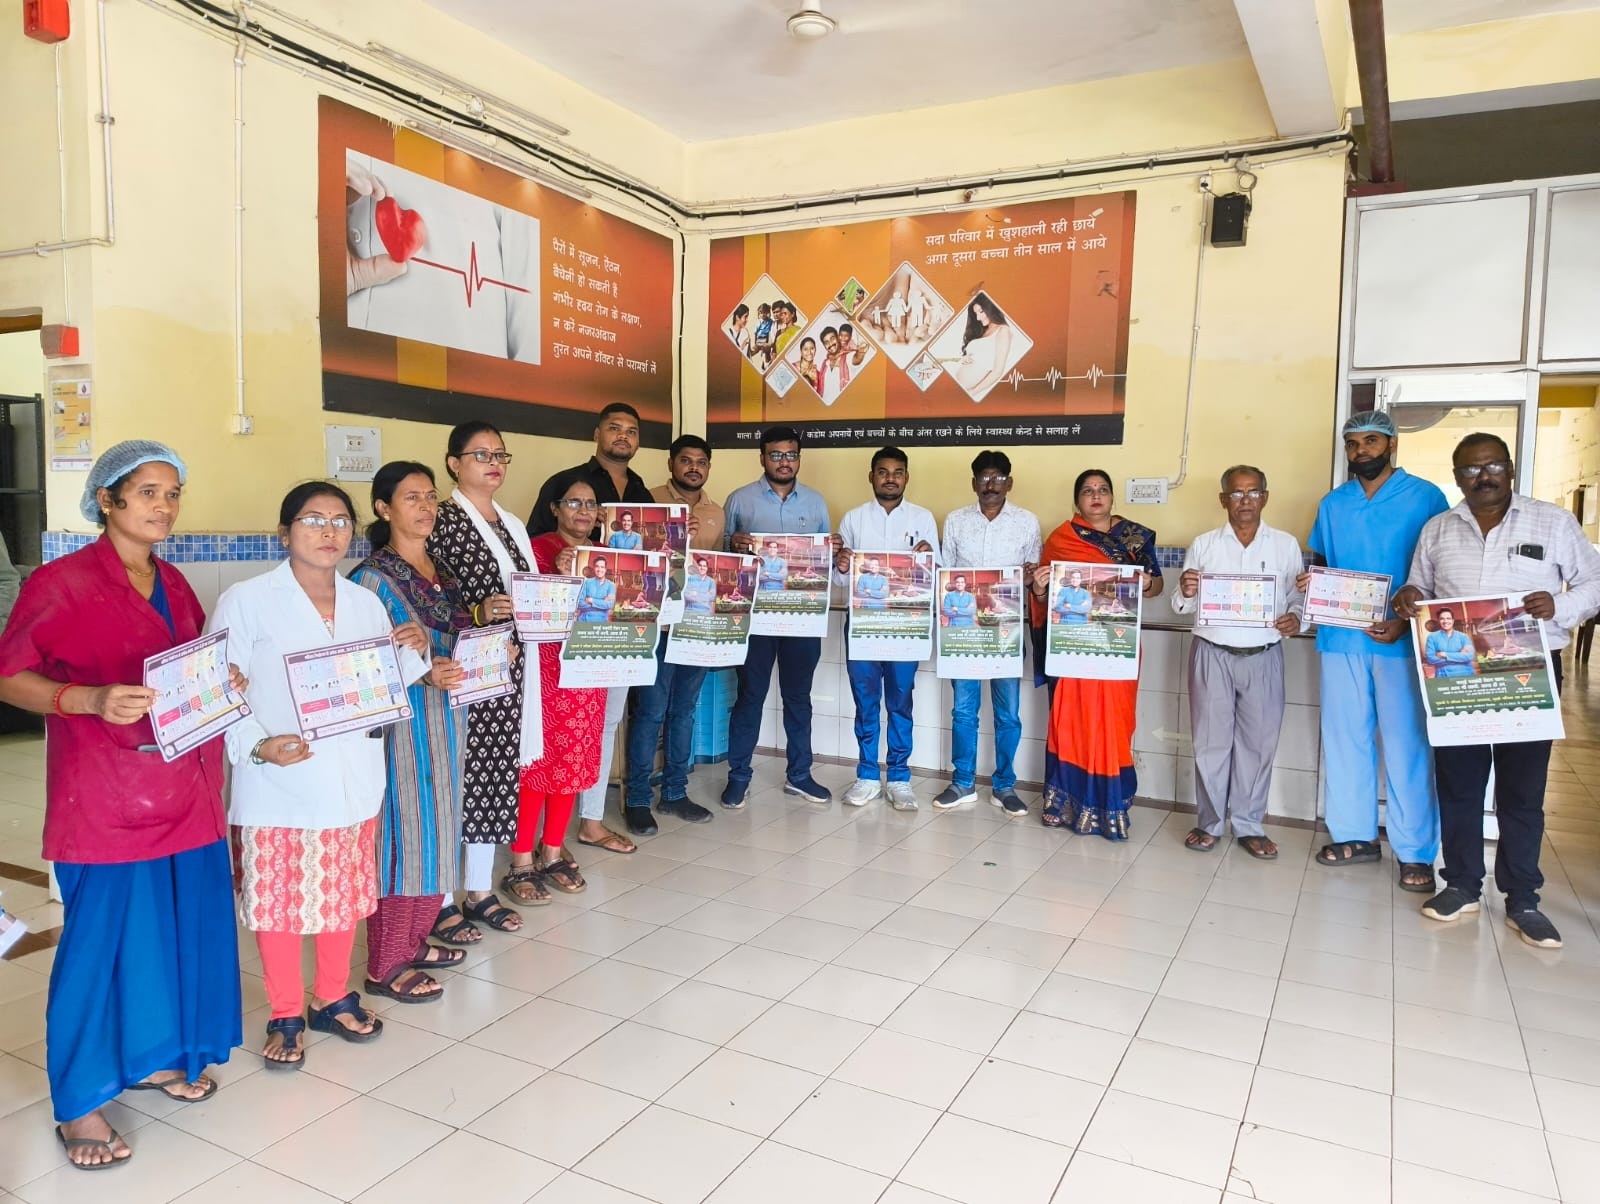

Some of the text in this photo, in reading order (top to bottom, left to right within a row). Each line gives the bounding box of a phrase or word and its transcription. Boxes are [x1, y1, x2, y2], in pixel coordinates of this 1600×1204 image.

[926, 234, 945, 246] सदा
[949, 228, 982, 244] परिवार
[986, 225, 994, 240] में
[999, 220, 1046, 241] खुशहाली
[1051, 218, 1068, 234] रही
[926, 253, 948, 265] अगर
[952, 250, 977, 267] दूसरा
[981, 247, 1009, 260] बच्चा
[1013, 242, 1033, 257] तीन
[1038, 242, 1062, 255] साल
[1067, 236, 1076, 252] में
[577, 271, 585, 288] हो
[588, 278, 610, 294] सकती
[595, 301, 608, 318] रोग
[610, 305, 619, 320] के
[552, 317, 560, 329] न
[552, 340, 570, 359] तुरंत
[572, 345, 592, 361] अपने
[617, 352, 624, 368] से
[626, 358, 648, 373] परामर्श
[888, 426, 896, 437] के
[898, 426, 914, 437] बीच
[917, 426, 933, 437] अंतर
[935, 425, 952, 437] रखने
[955, 425, 963, 437] के
[966, 424, 982, 437] लिये
[985, 427, 1013, 437] स्वास्थ्य
[1035, 424, 1043, 436] से
[1046, 426, 1069, 437] सलाह
